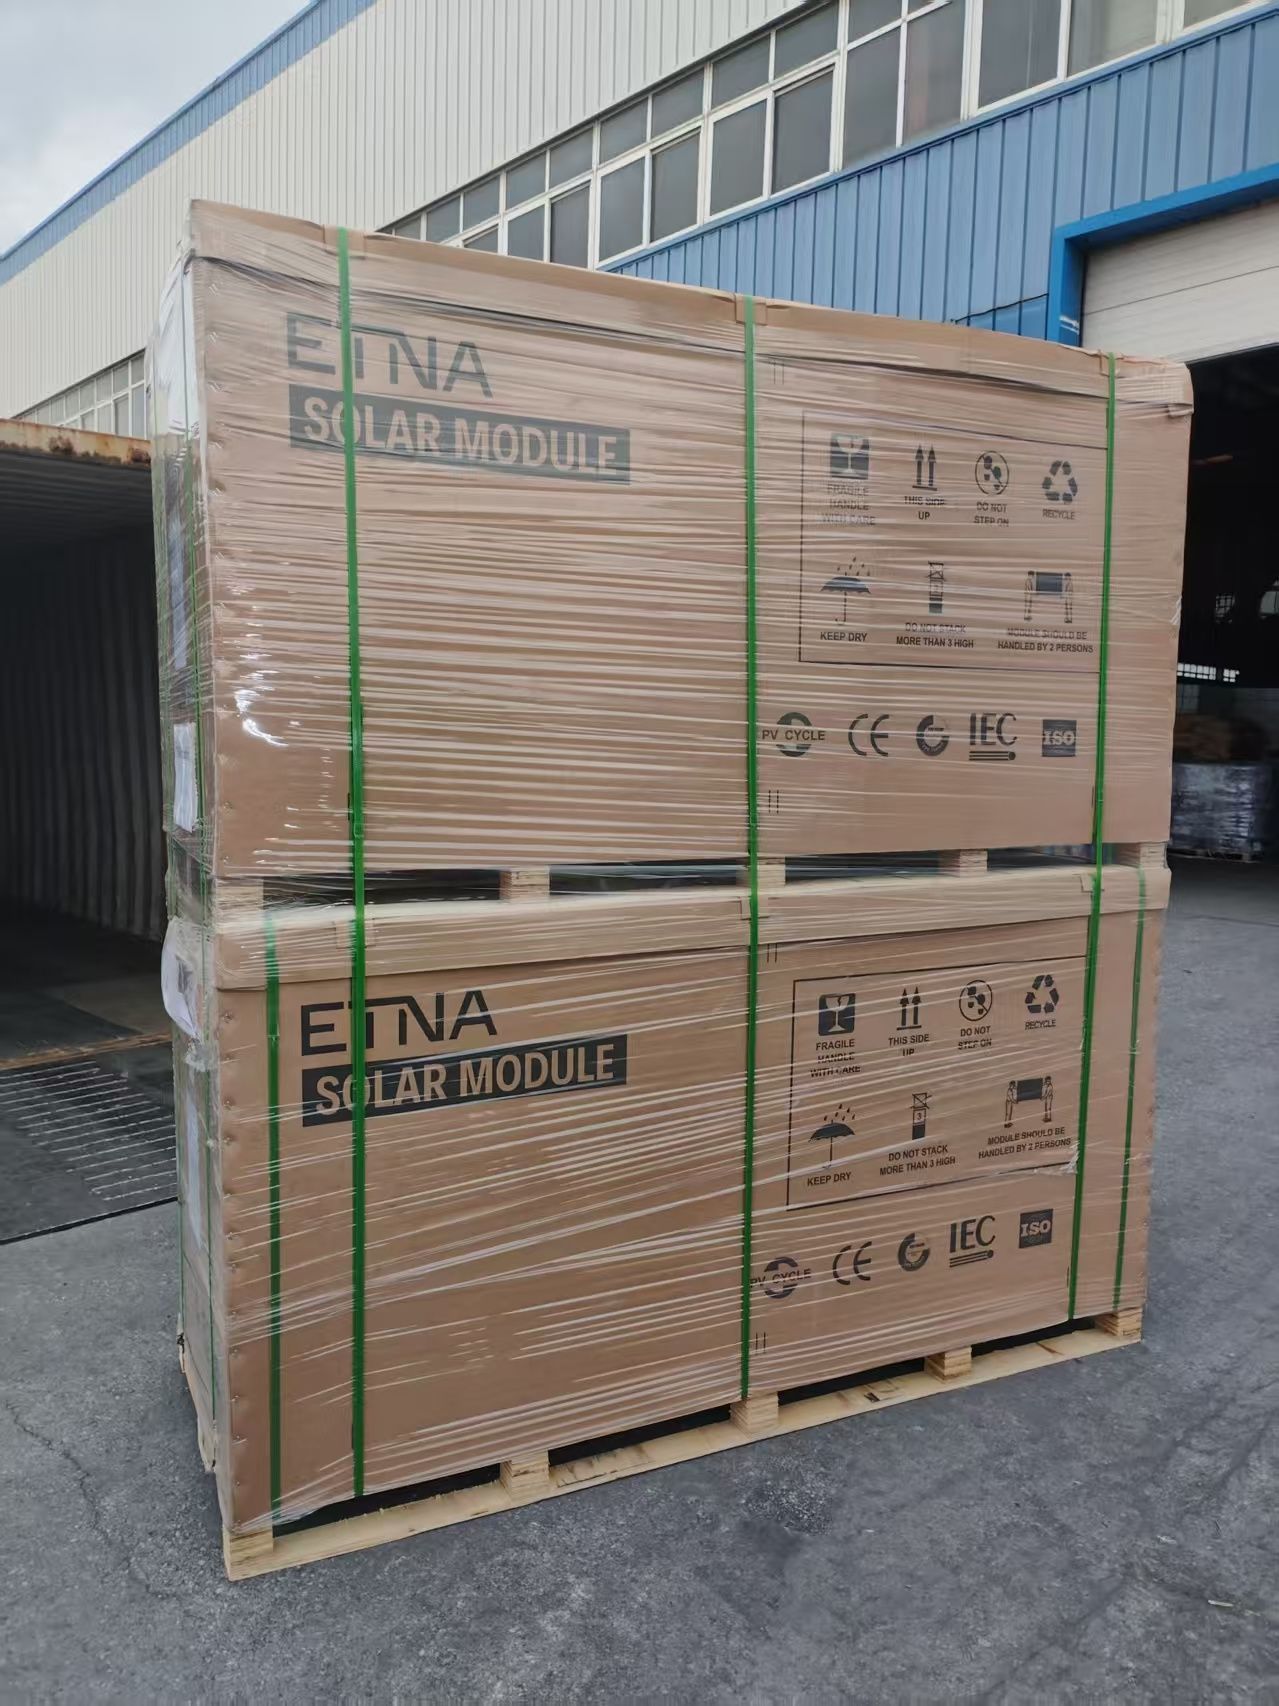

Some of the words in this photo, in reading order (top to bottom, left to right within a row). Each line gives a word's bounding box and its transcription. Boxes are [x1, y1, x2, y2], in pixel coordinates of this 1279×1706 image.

[287, 311, 493, 398] ETNA
[304, 396, 441, 456] SOLAR
[455, 418, 617, 476] MODULE
[904, 495, 923, 505] THIS
[976, 501, 989, 511] DO
[990, 503, 1007, 513] NOT
[918, 511, 930, 520] UP
[1042, 508, 1075, 520] RECYCLE
[820, 631, 846, 641] KEEP
[848, 632, 867, 642] DRY
[896, 636, 921, 646] MORE
[924, 637, 946, 647] THAN
[947, 638, 953, 647] 3
[954, 638, 974, 648] HIGH
[1076, 631, 1088, 640] BE
[998, 640, 1035, 651] HANDLED
[1036, 642, 1049, 652] BY
[1049, 643, 1054, 652] 2
[1055, 642, 1094, 654] PERSONS
[762, 730, 778, 740] PV
[785, 730, 826, 741] CYCLE
[848, 713, 889, 757] CE
[969, 712, 1017, 746] IEC
[1042, 730, 1076, 746] ISO
[301, 990, 497, 1057] ETNA
[960, 1028, 973, 1037] DO
[974, 1026, 991, 1035] NOT
[1025, 1019, 1056, 1030] RECYCLE
[815, 1039, 855, 1051] FRAGILE
[888, 1036, 908, 1047] THIS
[910, 1034, 930, 1043] SIDE
[980, 1039, 992, 1048] ON
[817, 1052, 855, 1064] HANDLE
[316, 1064, 447, 1116] SOLAR
[459, 1044, 616, 1099] MODULE
[987, 1132, 1020, 1145] MODULE
[1021, 1128, 1053, 1140] SHOULD
[1054, 1126, 1066, 1135] BE
[888, 1152, 901, 1162] DO
[903, 1149, 919, 1159] NOT
[921, 1144, 948, 1156] STACK
[978, 1145, 1015, 1159] HANDLED
[1016, 1143, 1027, 1152] BY
[1028, 1142, 1033, 1151] 2
[1034, 1137, 1072, 1150] PERSONS
[880, 1164, 904, 1176] MORE
[906, 1161, 928, 1172] THAN
[929, 1159, 935, 1168] 3
[936, 1156, 956, 1167] HIGH
[807, 1175, 832, 1187] KEEP
[833, 1171, 852, 1183] DRY
[950, 1215, 996, 1252] IEC
[1020, 1219, 1051, 1237] ISO
[832, 1240, 872, 1286] CE
[750, 1276, 766, 1288] PV
[772, 1268, 812, 1284] CYCLE
